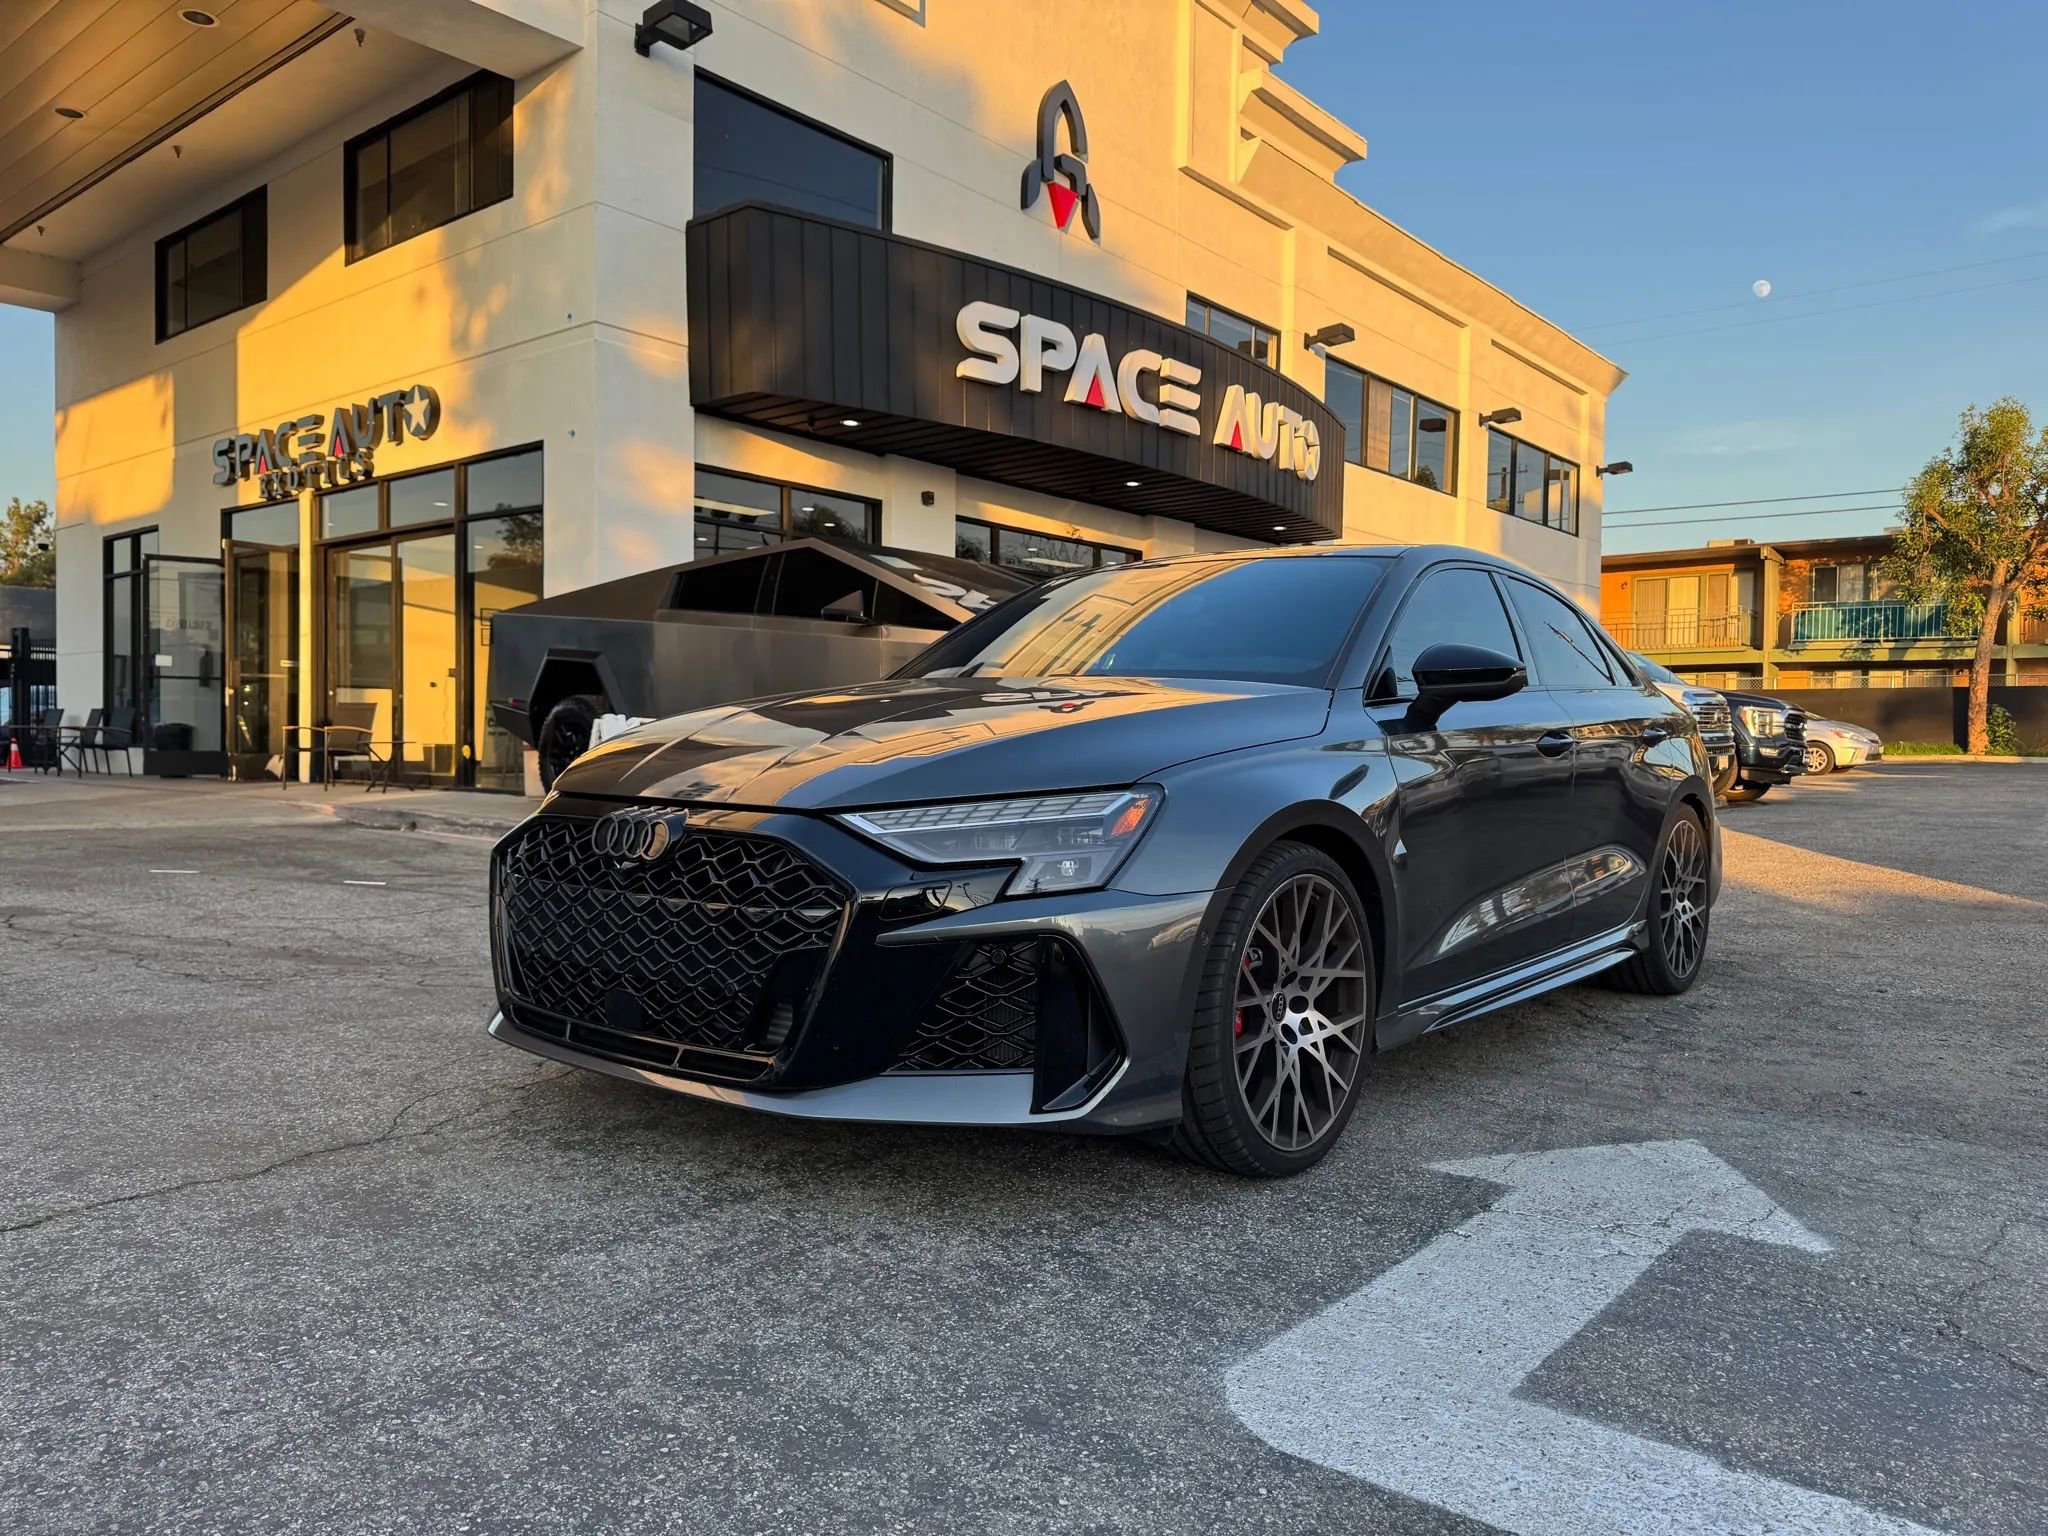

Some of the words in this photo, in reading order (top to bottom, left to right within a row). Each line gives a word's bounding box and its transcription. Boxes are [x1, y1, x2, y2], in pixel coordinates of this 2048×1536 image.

[213, 414, 325, 487] SPACE
[956, 300, 1201, 436] SPACE
[1213, 384, 1320, 481] AUTO
